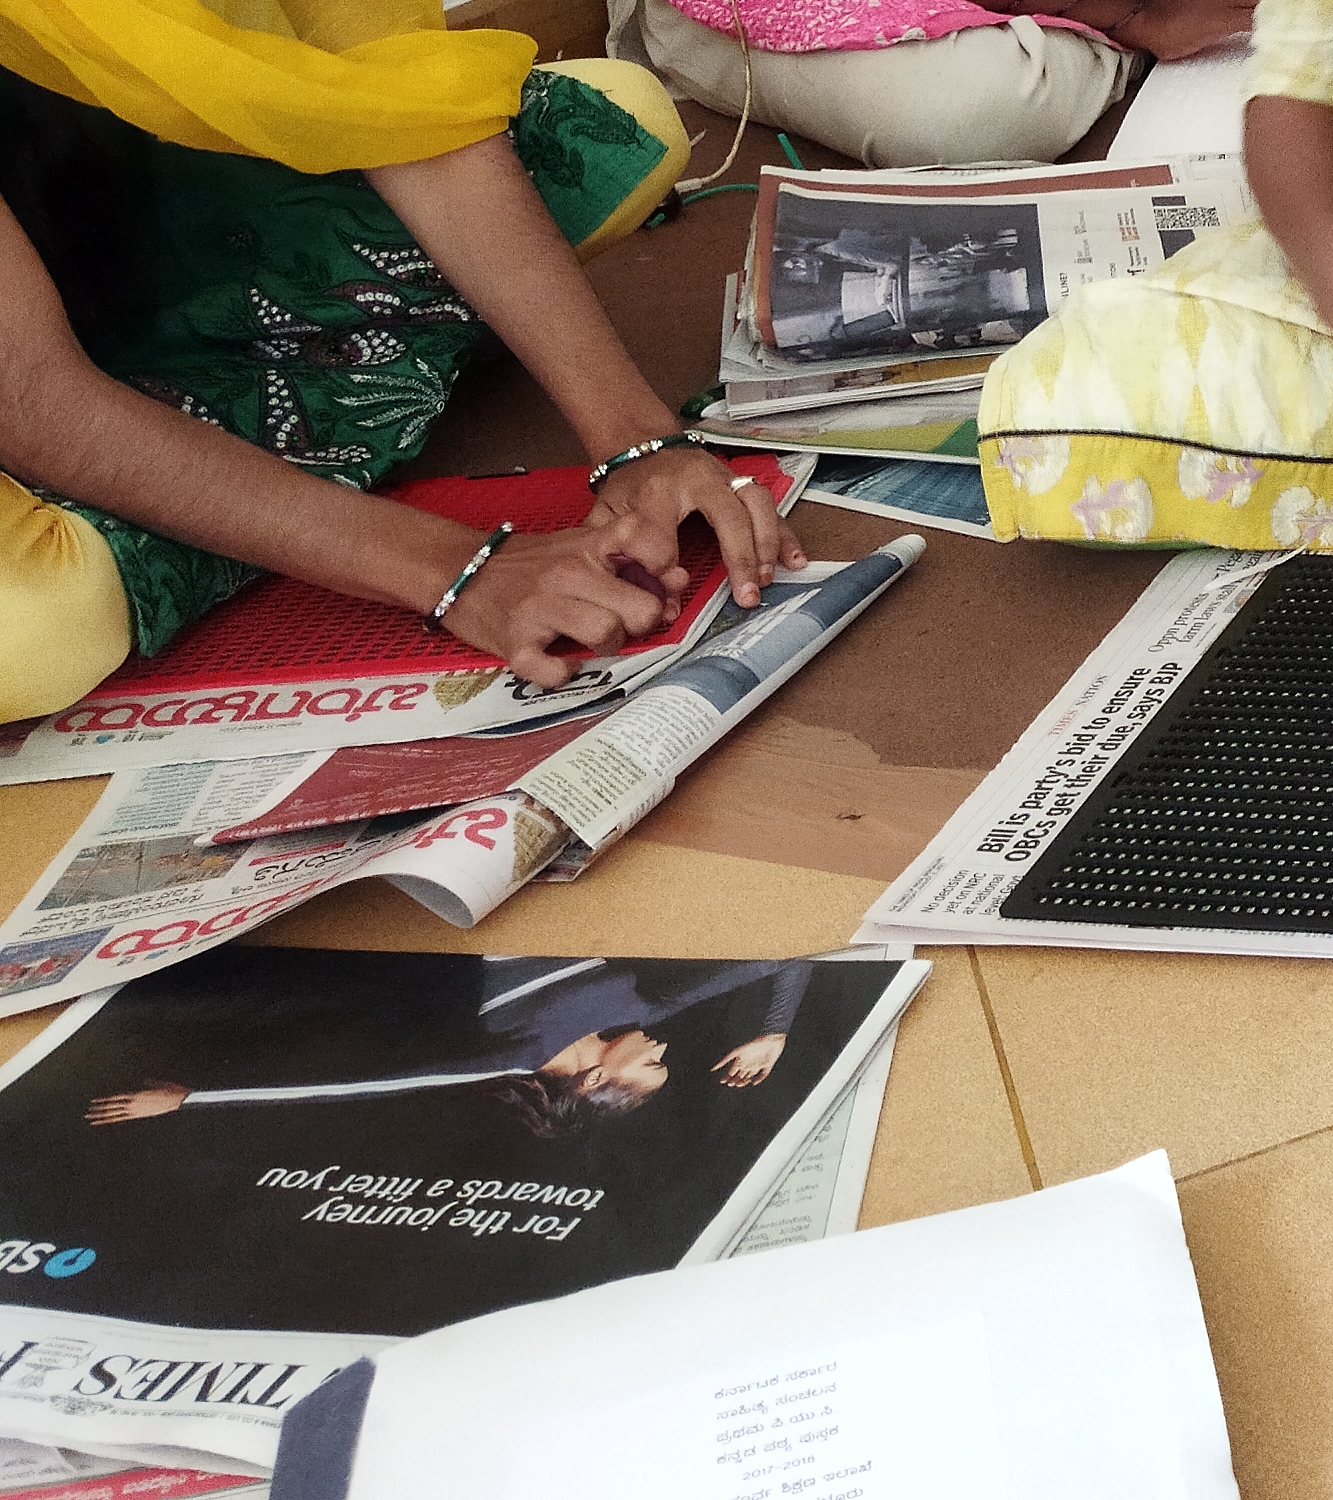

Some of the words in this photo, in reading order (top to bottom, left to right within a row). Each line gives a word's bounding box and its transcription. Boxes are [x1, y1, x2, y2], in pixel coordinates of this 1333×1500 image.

[1149, 662, 1183, 684] BJP
[1049, 709, 1079, 736] TIMES
[1075, 675, 1109, 706] NATION
[1127, 689, 1165, 721] says
[1098, 722, 1142, 751] due,
[976, 821, 1017, 853] Bill
[1006, 813, 1030, 827] is
[1019, 766, 1069, 810] party’s
[1057, 733, 1095, 756] bid
[1082, 717, 1111, 734] to
[1102, 668, 1151, 715] ensure
[1063, 755, 1110, 789] their
[1046, 790, 1081, 816] get
[1004, 820, 1057, 862] OBCs
[920, 903, 939, 913] No
[935, 869, 969, 901] decision
[943, 901, 961, 913] yet
[956, 890, 971, 899] on
[964, 872, 986, 888] NRC
[963, 906, 976, 915] at
[972, 874, 1004, 906] national
[254, 1153, 334, 1197] you
[329, 1167, 423, 1205] fitter
[433, 1176, 453, 1199] a
[301, 1186, 450, 1237] journey
[454, 1172, 604, 1220] towards
[448, 1206, 510, 1240] the
[511, 1209, 580, 1244] For
[74, 1352, 311, 1430] TIMES
[712, 1374, 780, 1399] ಕರ್ನಾಟಕ
[783, 1360, 838, 1382] ಸರ್ಕಾರ
[714, 1399, 769, 1421] ಸಾಹಿತ್ಯ
[773, 1382, 838, 1406] ಸಂಚಲನ
[714, 1422, 765, 1445] ಪ್ರಥಮ
[715, 1445, 757, 1467] ಕನ್ನಡ
[762, 1436, 792, 1455] ಪಠ್ಯ
[798, 1425, 840, 1445] ಪುಸ್ತಕ
[740, 1454, 817, 1480] 2017-2018
[780, 1475, 817, 1496] ಶಿಕ್ಷಣ
